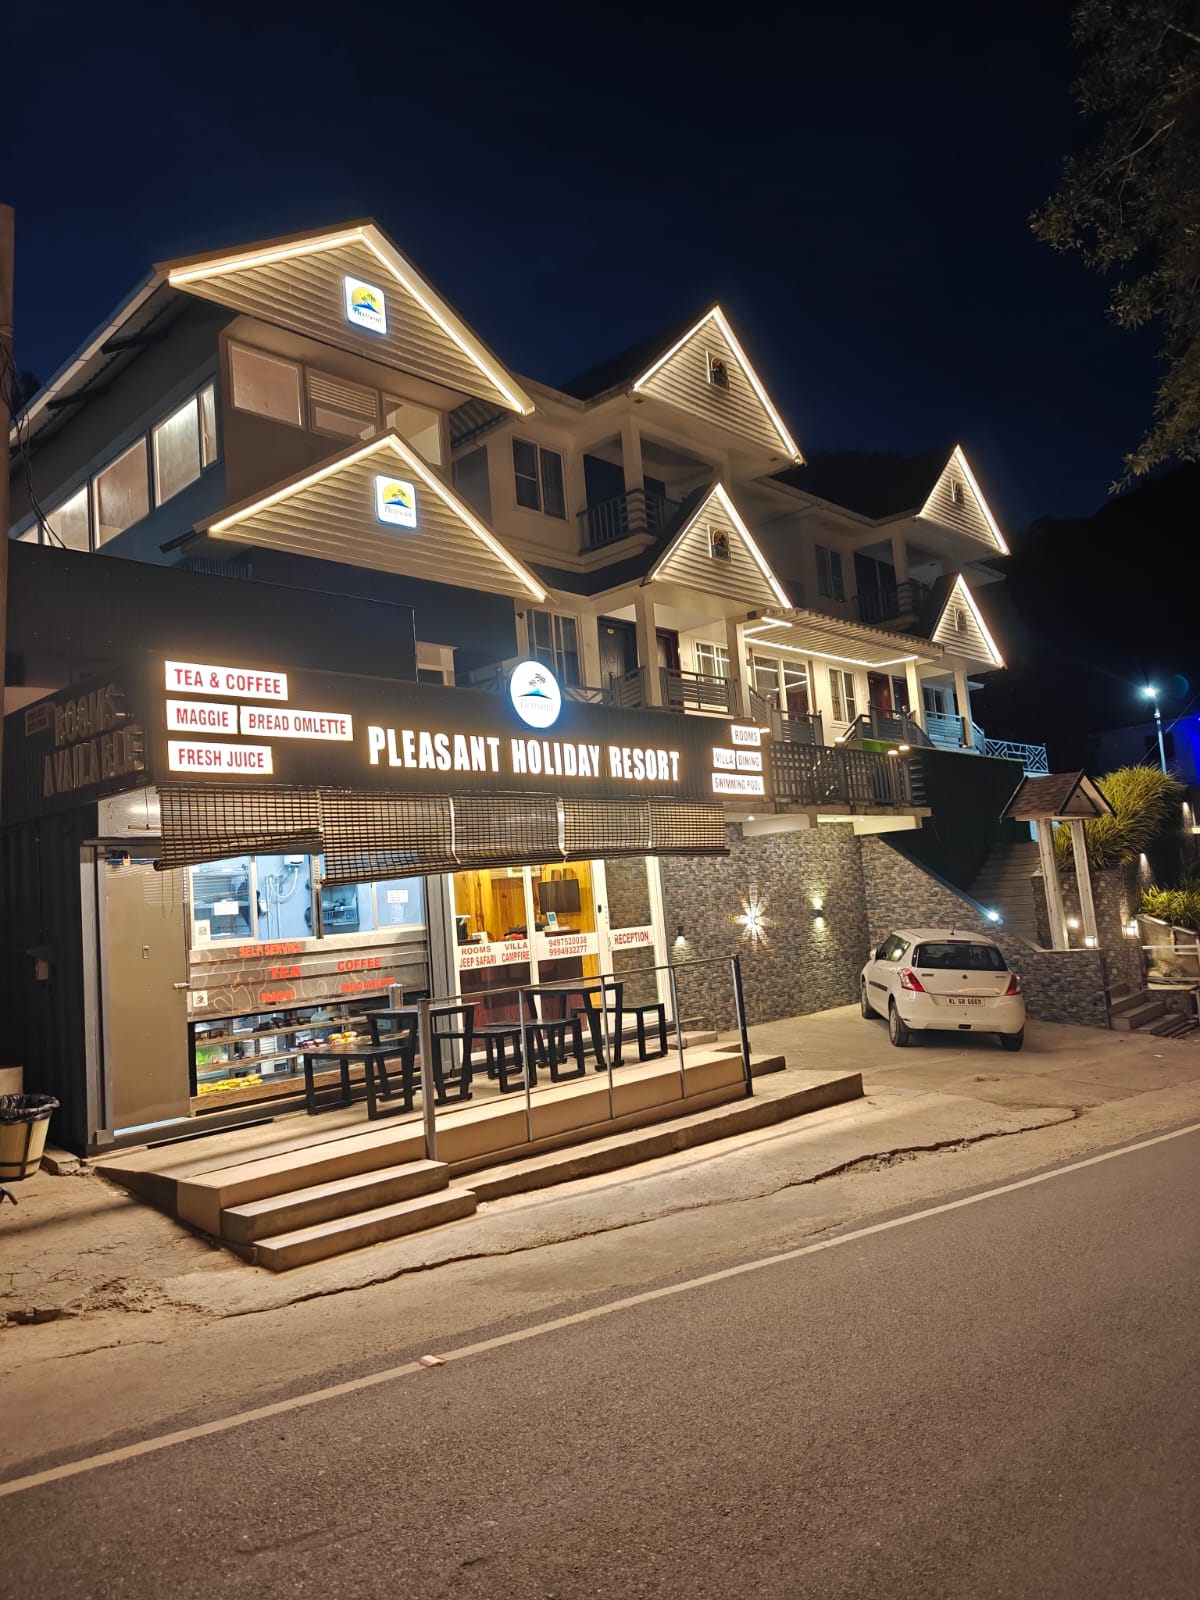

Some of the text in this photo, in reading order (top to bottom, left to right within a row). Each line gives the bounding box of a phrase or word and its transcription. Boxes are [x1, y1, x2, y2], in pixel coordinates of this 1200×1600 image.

[174, 668, 281, 694] TEA & COFFEE
[176, 708, 229, 727] MAGGIE
[248, 713, 346, 735] BREAD OMLETTE
[734, 729, 758, 742] ROOMS
[178, 748, 264, 768] FRESH JUICE
[367, 726, 680, 782] PLEASANT HOLIDAY RESORT
[715, 752, 734, 765] VILLA
[738, 755, 760, 767] DINING
[715, 777, 761, 791] SWIMMING POOL
[614, 930, 649, 945] RECEPTION
[461, 942, 528, 956] ROOMS VILLA
[337, 957, 382, 972] COFFEE
[459, 951, 530, 968] JEEP SAFARI CAMPFIRE
[268, 965, 301, 980] TEA
